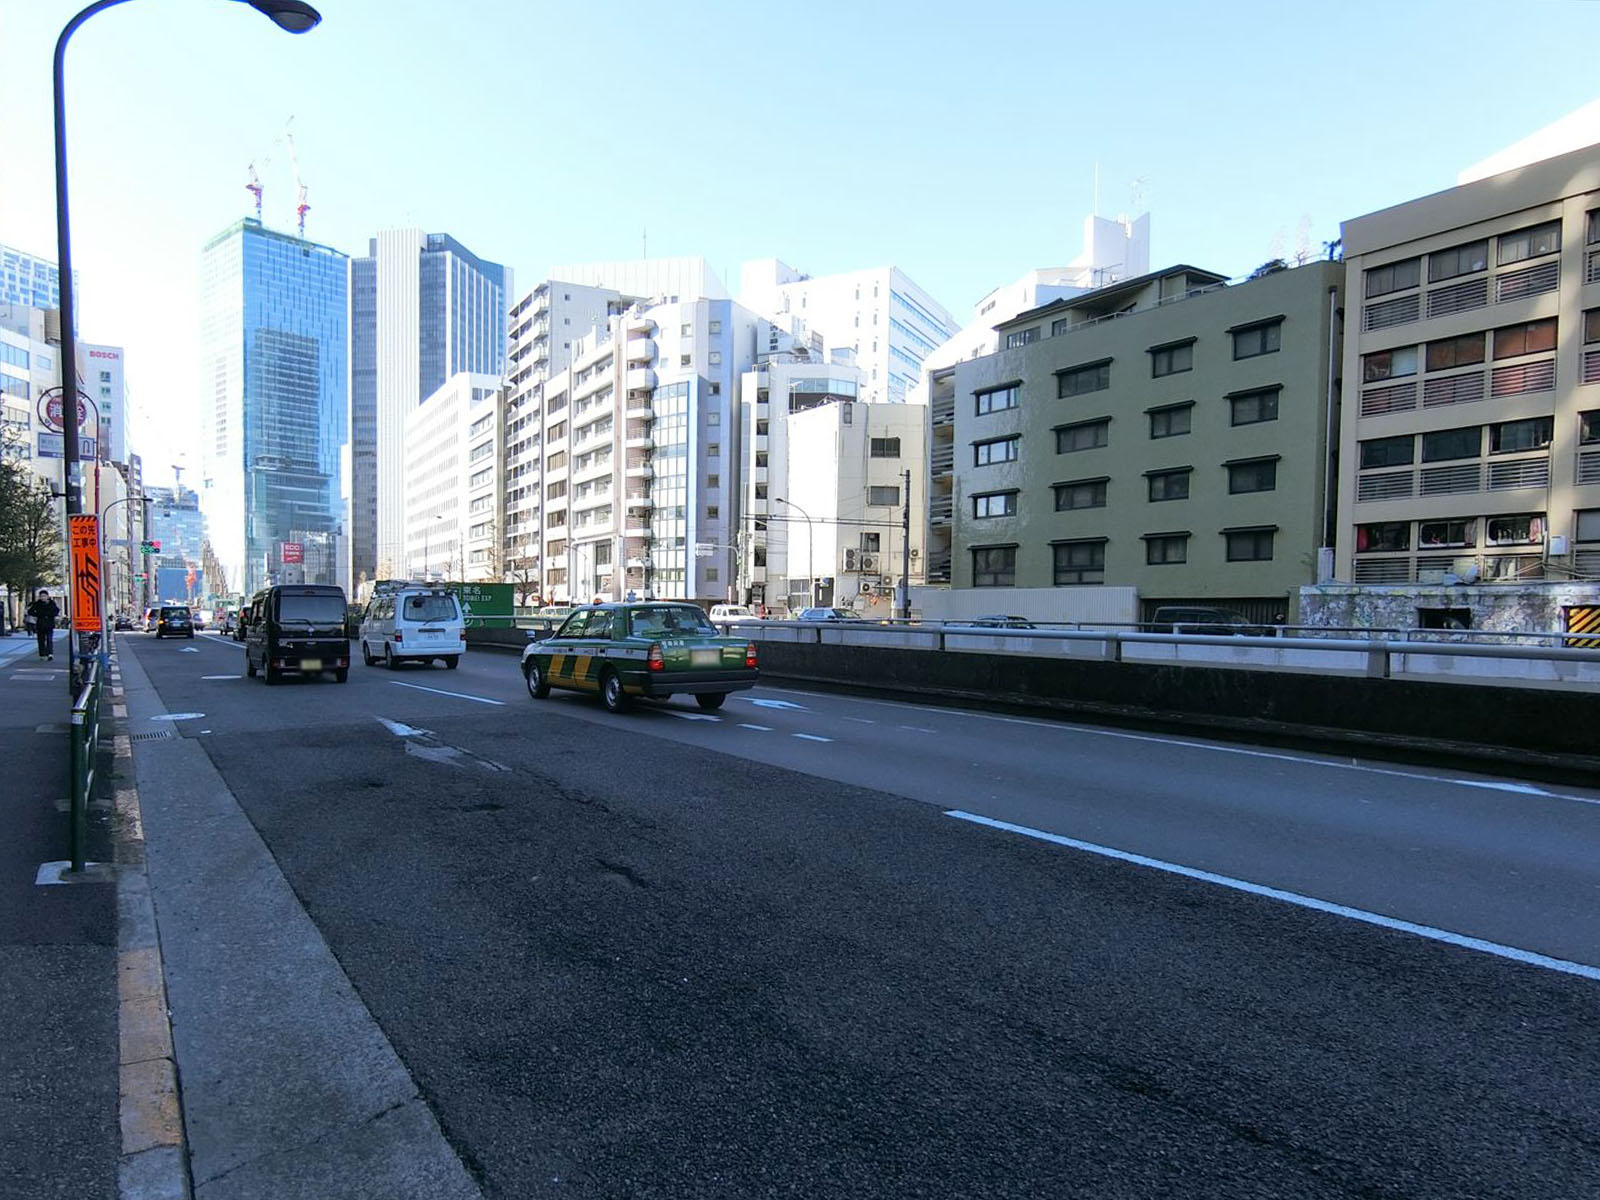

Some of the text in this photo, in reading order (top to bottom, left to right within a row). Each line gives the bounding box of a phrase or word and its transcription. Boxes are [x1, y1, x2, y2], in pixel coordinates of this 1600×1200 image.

[89, 350, 119, 360] BOSCH
[72, 525, 96, 535] この先
[73, 537, 97, 548] 工事中
